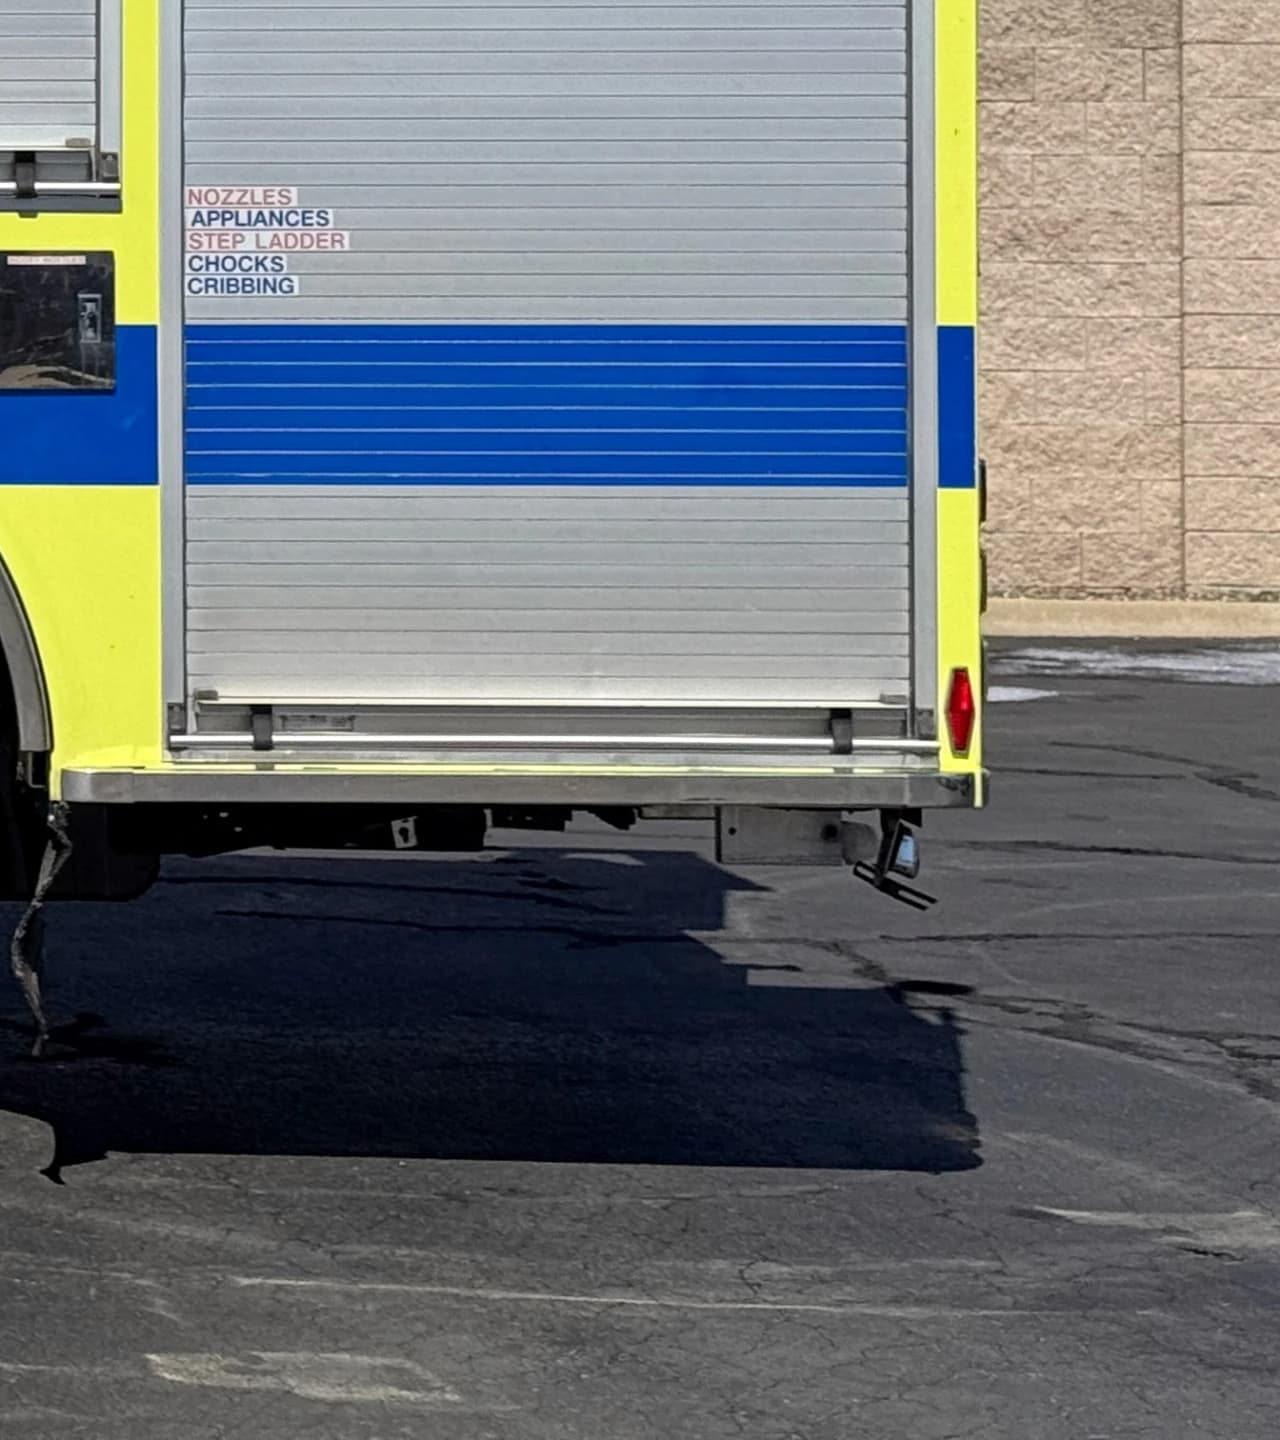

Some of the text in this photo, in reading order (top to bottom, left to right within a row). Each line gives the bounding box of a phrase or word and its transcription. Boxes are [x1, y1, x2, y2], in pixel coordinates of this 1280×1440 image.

[187, 188, 293, 206] NOZZLES
[191, 209, 331, 227] APPLIANCES
[188, 232, 346, 250] STEP LADDER
[187, 254, 285, 273] CHOCKS
[186, 277, 295, 295] CRIBBING
